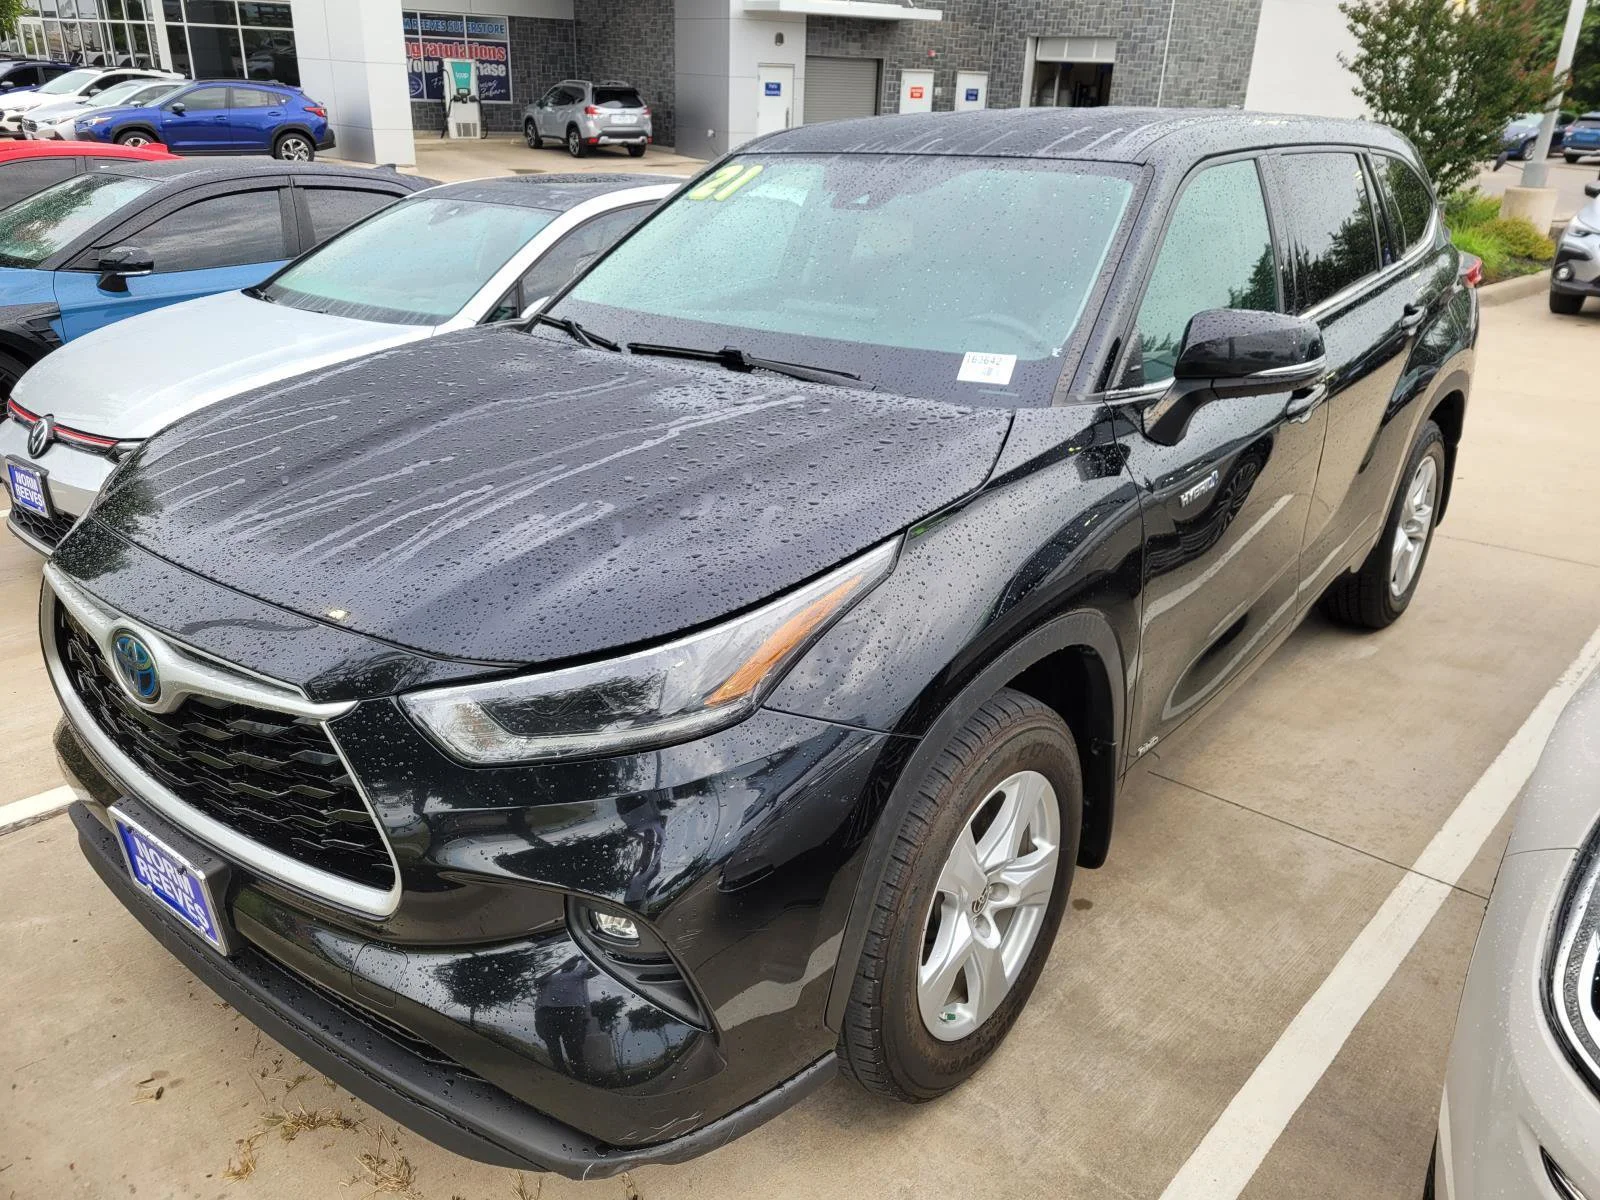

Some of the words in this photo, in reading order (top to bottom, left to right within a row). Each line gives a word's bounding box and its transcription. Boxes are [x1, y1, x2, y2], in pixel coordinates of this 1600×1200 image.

[447, 20, 505, 34] SUPERSTORE
[14, 469, 39, 492] NORM
[15, 481, 43, 506] REEVES
[133, 835, 196, 900] NORM
[135, 854, 210, 930] REEVES
